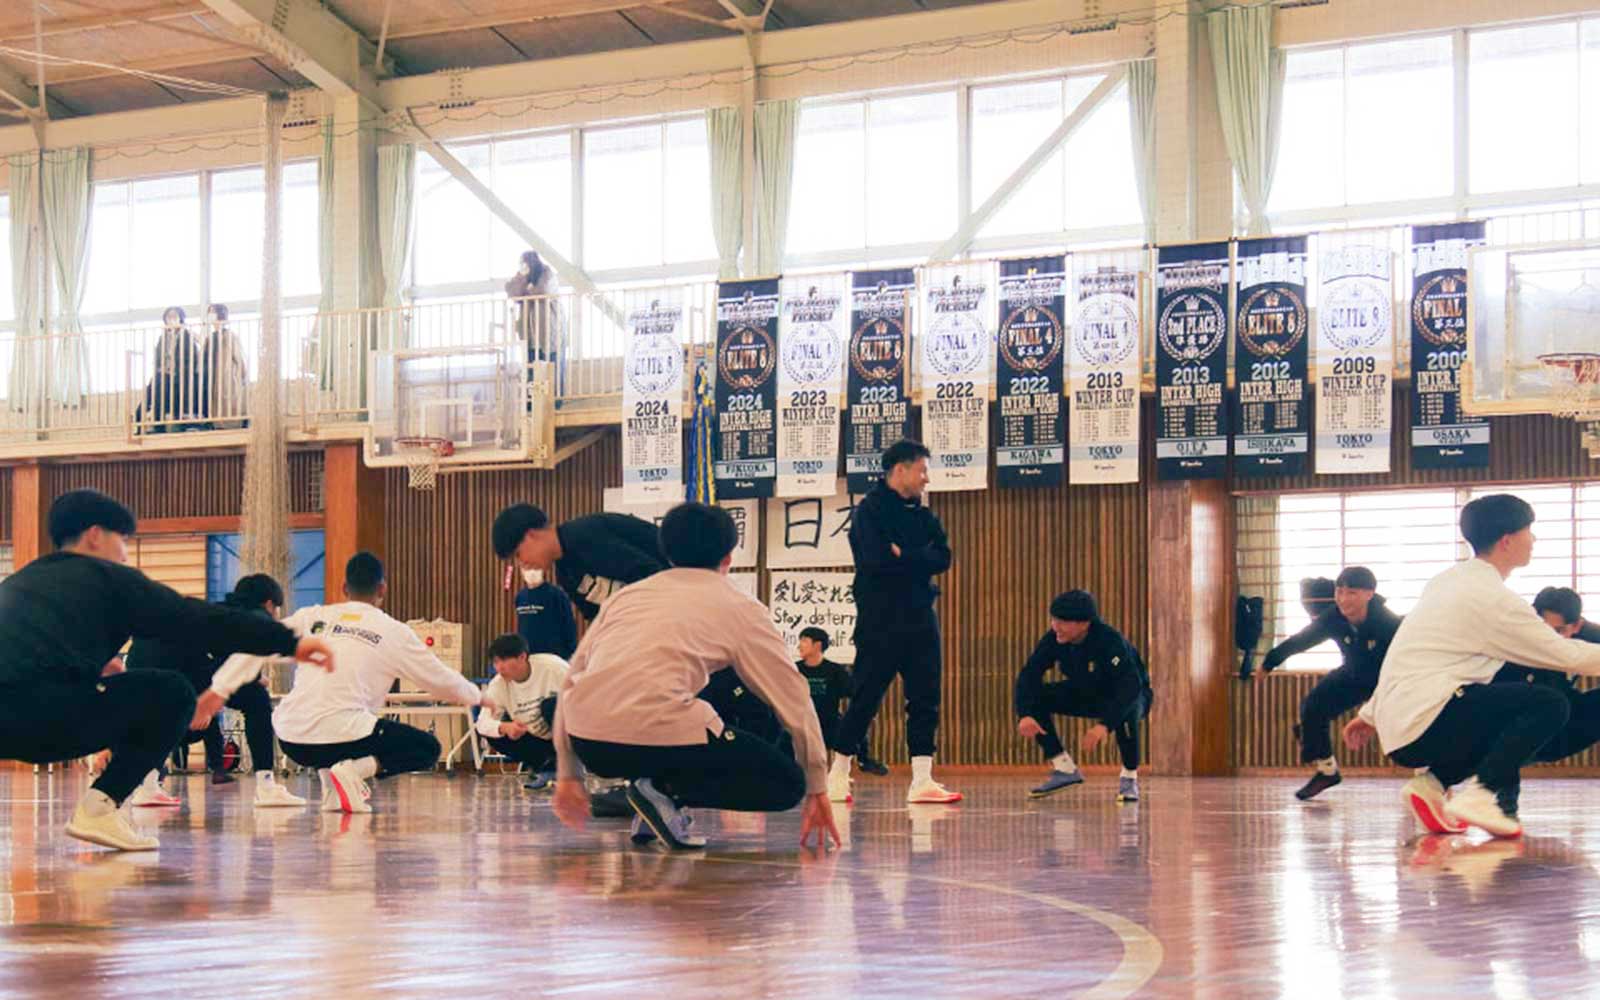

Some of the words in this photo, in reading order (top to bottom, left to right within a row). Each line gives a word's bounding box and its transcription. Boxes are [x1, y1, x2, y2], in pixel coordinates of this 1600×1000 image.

[1423, 298, 1462, 319] FINAL
[1083, 320, 1117, 340] FINAL
[1187, 315, 1216, 334] PLACE
[1248, 313, 1284, 335] ELITE
[1287, 312, 1295, 334] 8
[935, 333, 968, 352] FINAL
[1008, 327, 1041, 346] FINAL
[1045, 327, 1053, 345] 4
[860, 342, 891, 361] ELITE
[894, 341, 901, 359] 8
[726, 350, 758, 370] ELITE
[760, 350, 766, 368] 8
[1333, 356, 1375, 375] 2009
[1172, 367, 1210, 385] 2013
[1251, 362, 1290, 380] 2012
[1417, 370, 1451, 385] INTER
[1010, 377, 1049, 394] 2022
[1087, 372, 1123, 389] 2013
[1240, 381, 1272, 395] INTER
[1276, 379, 1302, 394] HIGH
[1322, 376, 1362, 389] WINTER
[1366, 374, 1386, 388] CUP
[791, 390, 827, 407] 2023
[861, 386, 897, 403] 2023
[937, 382, 974, 399] 2022
[1075, 389, 1112, 405] WINTER
[1116, 387, 1135, 403] CUP
[1160, 385, 1192, 400] INTER
[1195, 383, 1222, 398] HIGH
[636, 400, 669, 416] 2024
[728, 393, 763, 411] 2024
[928, 399, 962, 412] WINTER
[966, 398, 984, 411] CUP
[1001, 395, 1031, 409] INTER
[1034, 393, 1059, 408] HIGH
[783, 408, 816, 420] WINTER
[818, 406, 836, 419] CUP
[852, 404, 879, 417] INTER
[883, 402, 906, 416] HIGH
[628, 416, 659, 430] WINTER
[661, 415, 677, 428] CUP
[720, 411, 747, 425] INTER
[1336, 433, 1373, 444] TOKYO
[1433, 429, 1471, 440] OSAKA
[1011, 449, 1052, 460] KAGAWA
[1088, 445, 1123, 456] TOKYO
[1176, 441, 1207, 452] OITA
[793, 461, 823, 470] TOKYO
[854, 457, 882, 468] HOKK
[941, 453, 972, 463] TOKYO
[639, 468, 668, 478] TOKYO
